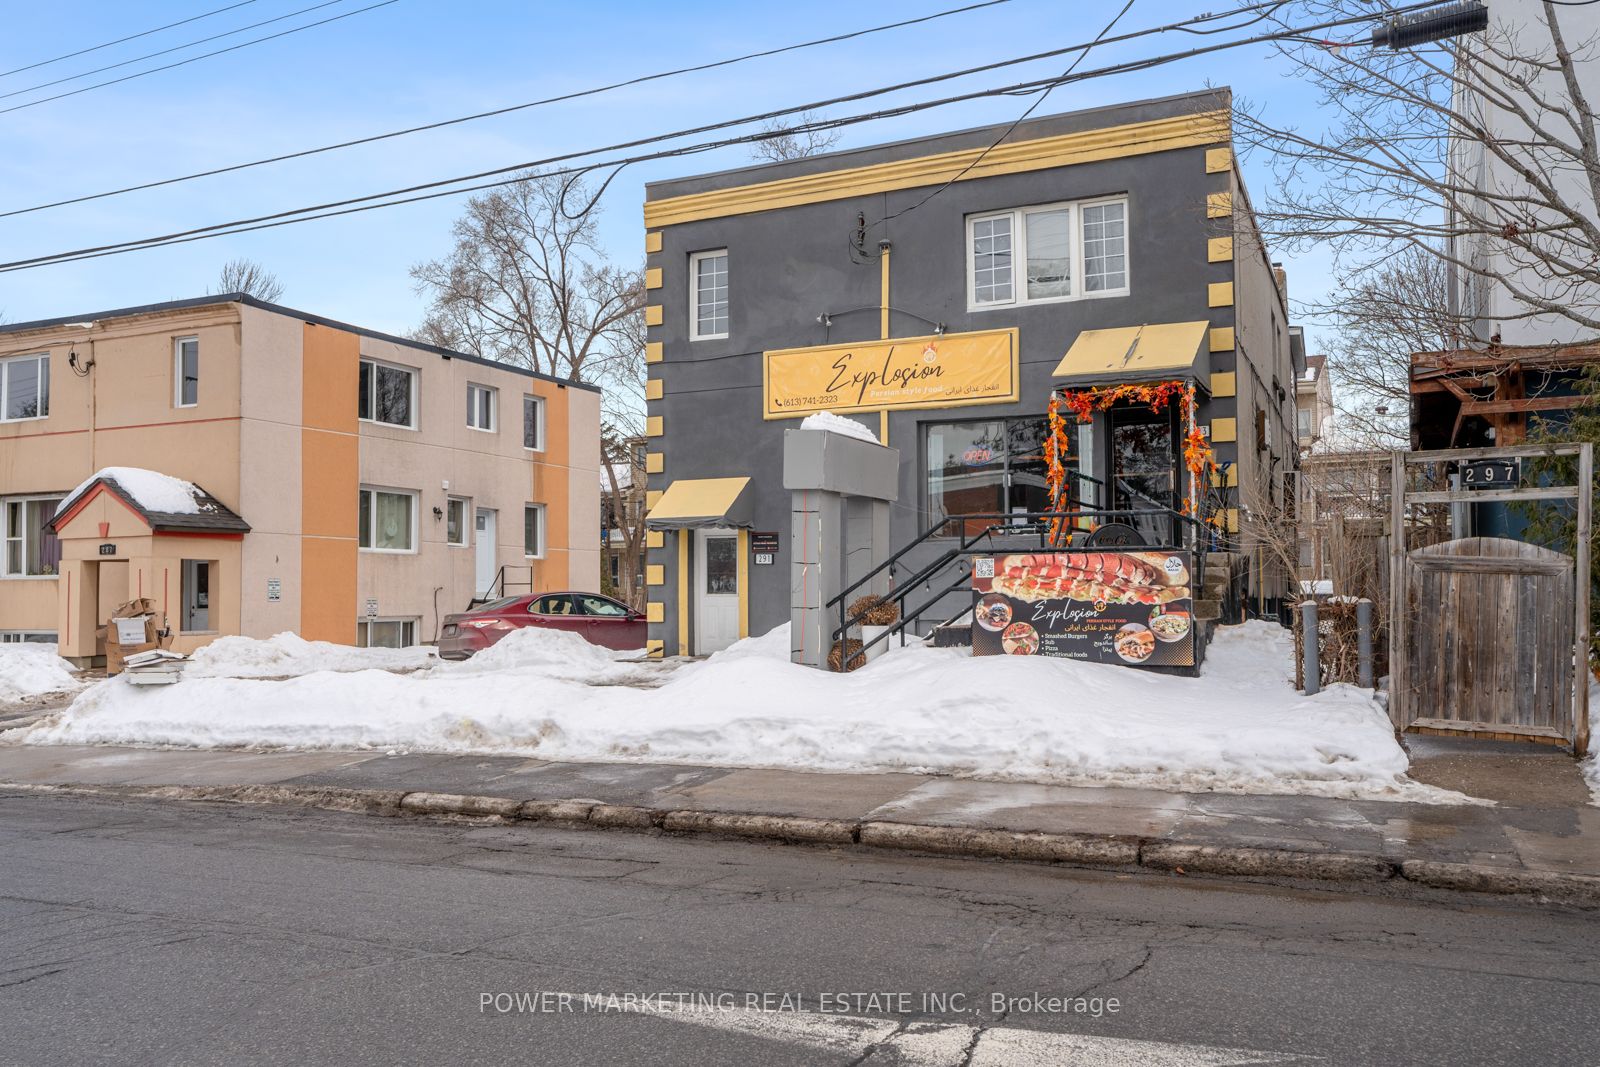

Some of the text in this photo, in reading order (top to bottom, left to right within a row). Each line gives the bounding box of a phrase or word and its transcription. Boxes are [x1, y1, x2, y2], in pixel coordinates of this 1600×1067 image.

[825, 346, 945, 405] Explosion
[783, 395, 838, 407] (613) 741-2323
[963, 450, 990, 461] OPEN
[1466, 467, 1513, 481] 297
[758, 555, 771, 563] 291
[1031, 599, 1100, 629] Explosion
